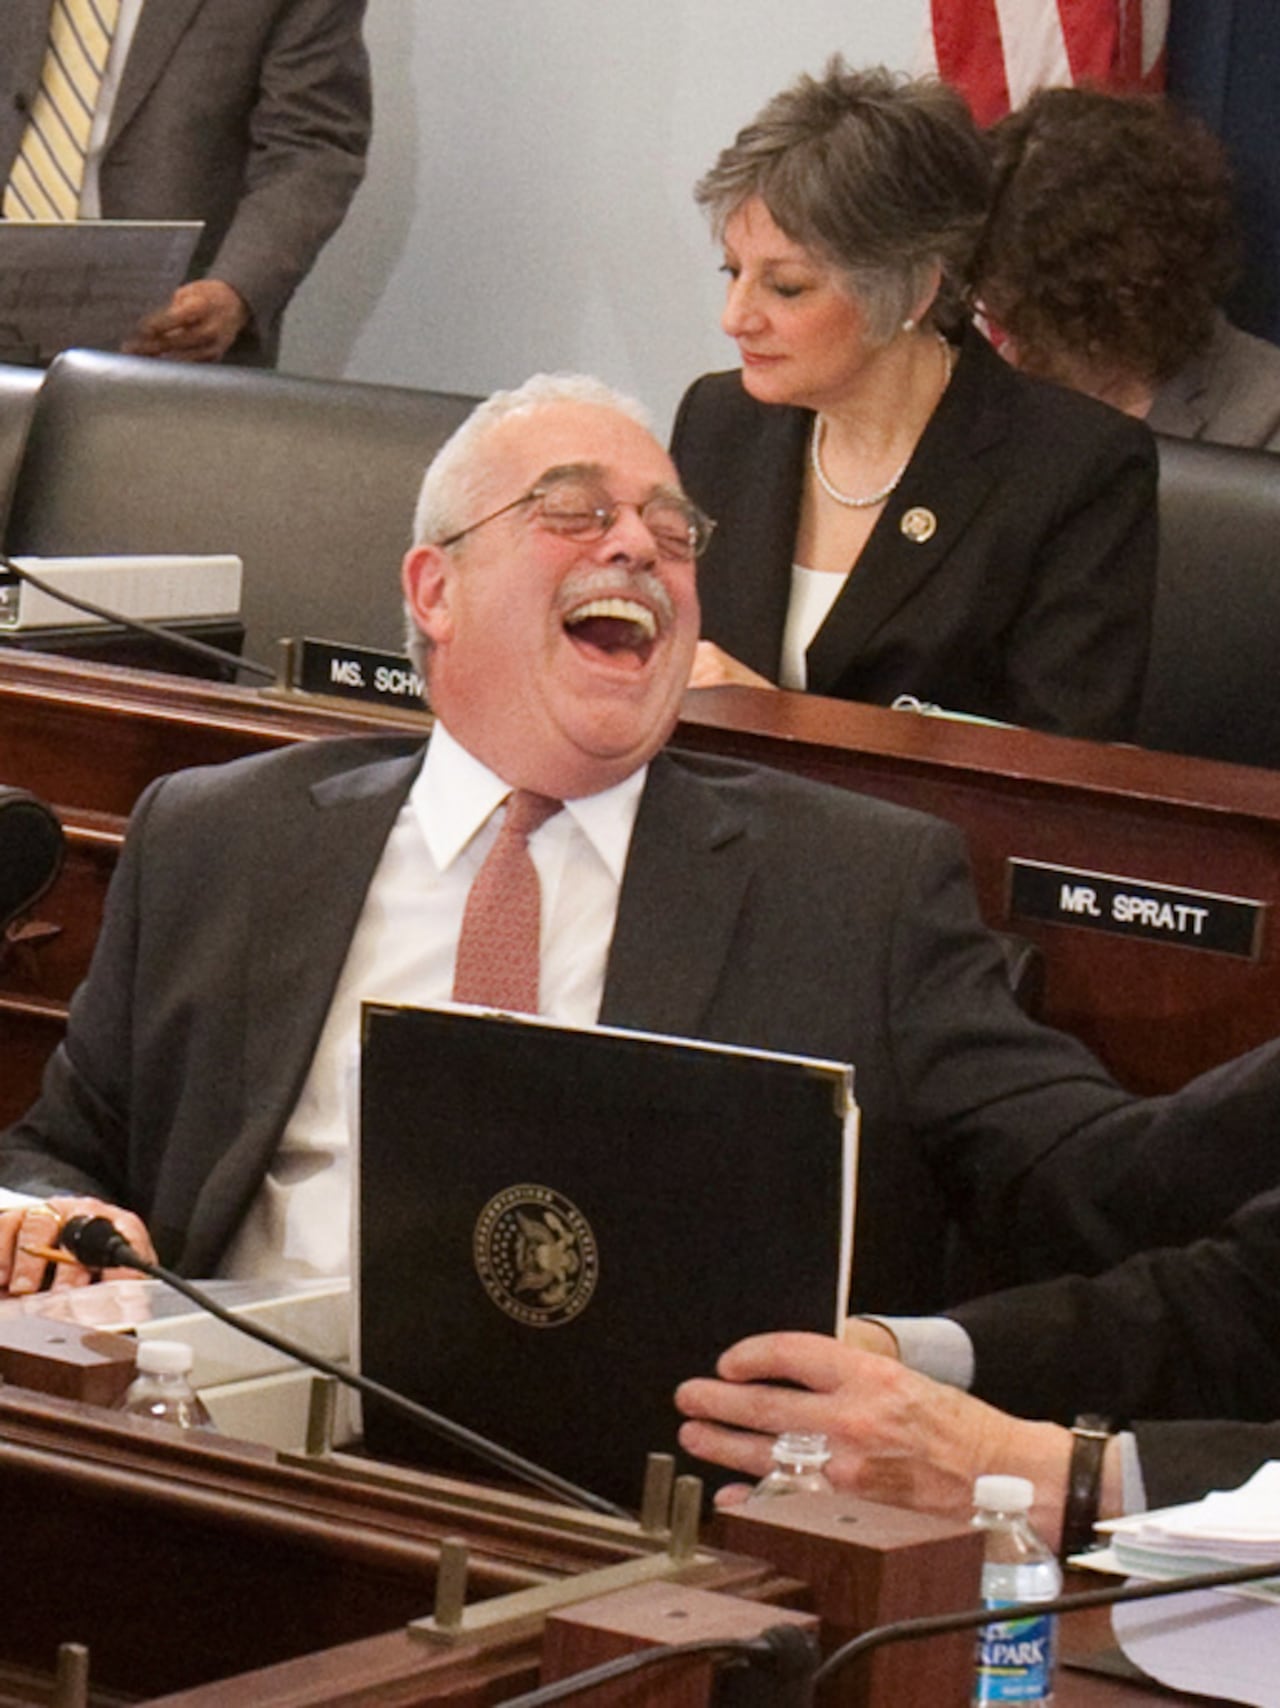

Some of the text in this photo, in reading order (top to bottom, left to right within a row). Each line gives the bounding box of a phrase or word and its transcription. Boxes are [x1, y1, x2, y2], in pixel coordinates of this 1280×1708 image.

[331, 659, 365, 687] MS.
[1060, 884, 1208, 935] MR. SPRATT
